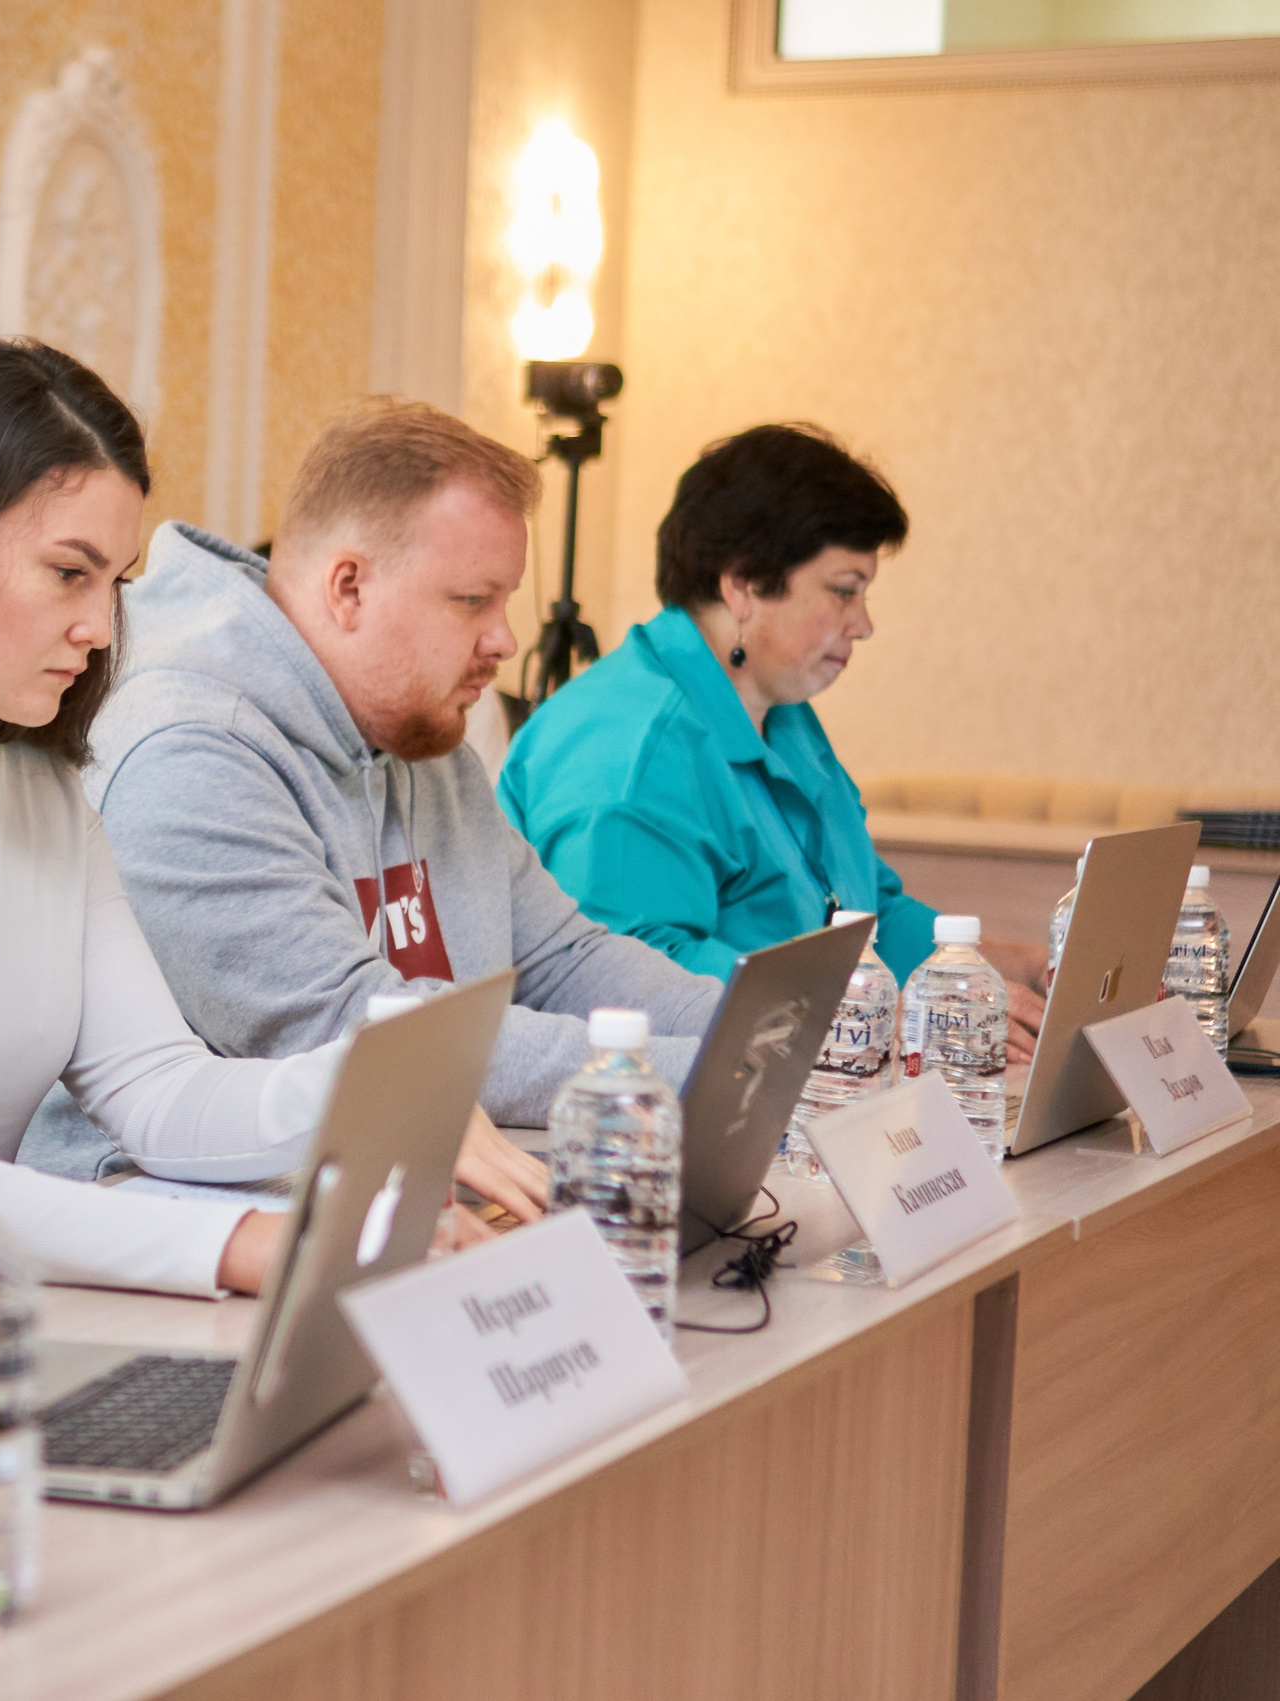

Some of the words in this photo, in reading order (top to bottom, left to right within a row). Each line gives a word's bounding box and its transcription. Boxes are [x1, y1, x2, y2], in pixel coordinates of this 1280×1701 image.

[1142, 1035, 1174, 1059] Илья
[883, 1127, 923, 1157] Анна
[891, 1168, 968, 1215] Каминская
